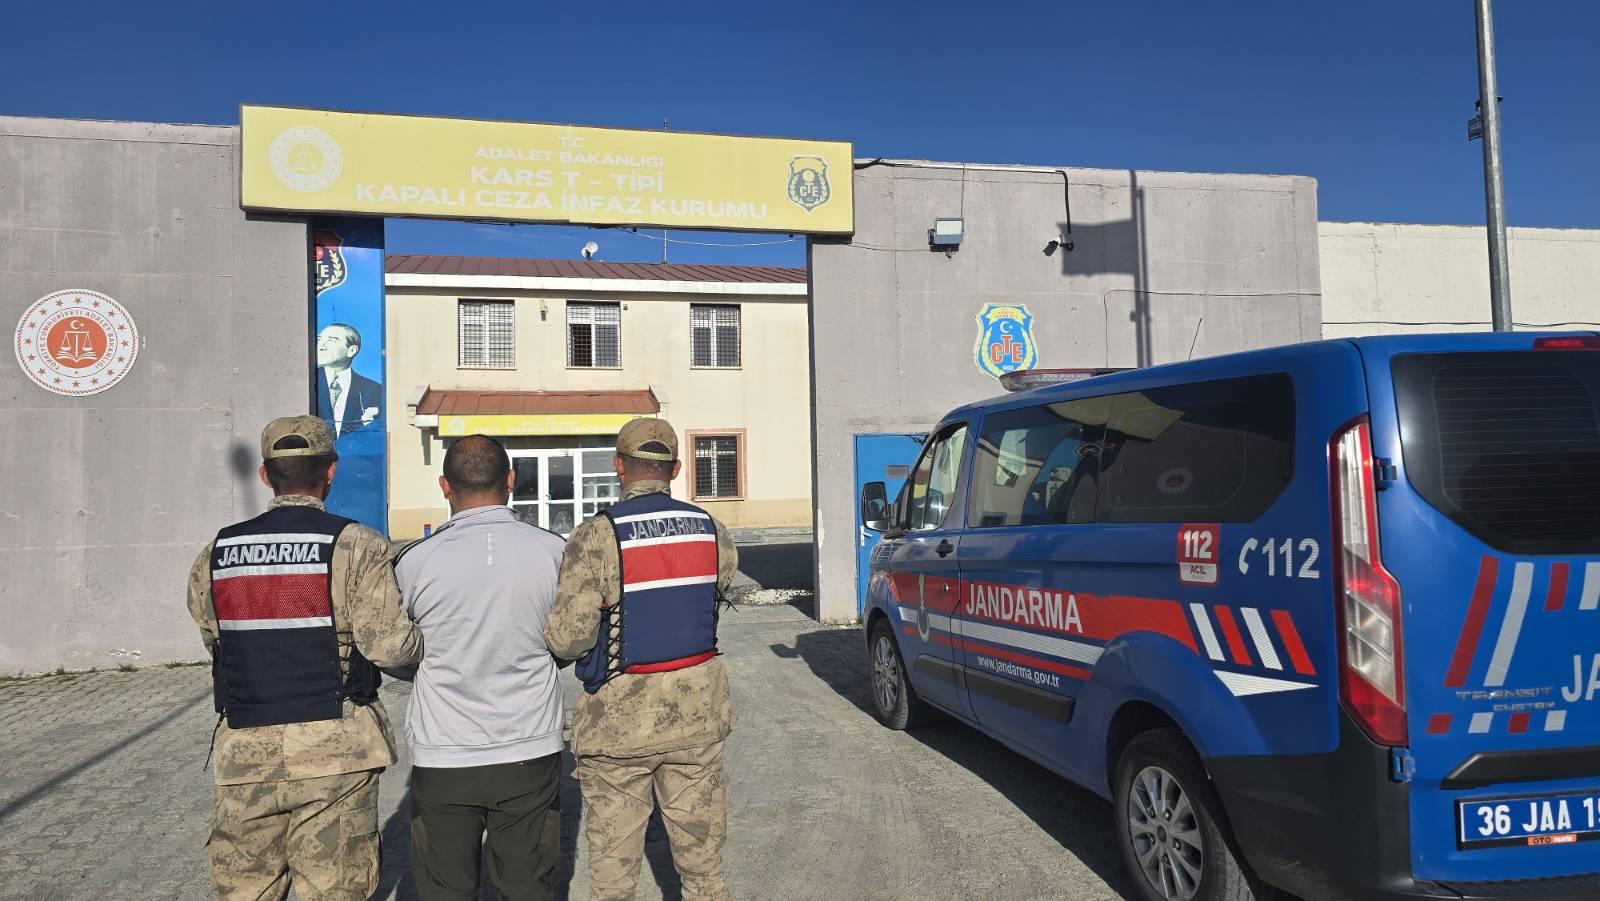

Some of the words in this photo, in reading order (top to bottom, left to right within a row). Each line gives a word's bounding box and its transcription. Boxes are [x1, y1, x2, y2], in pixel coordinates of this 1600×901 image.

[475, 146, 554, 162] ADALET
[560, 151, 664, 168] BAKANLIĞI
[471, 165, 553, 187] KARS
[562, 171, 580, 188] T
[610, 171, 664, 193] TİPİ
[800, 182, 819, 197] CTE
[356, 183, 465, 206] KAPALI
[475, 189, 553, 209] CEZA
[561, 190, 643, 214] İNFAZ
[651, 199, 767, 220] KURUMU
[991, 335, 1023, 363] CTE
[629, 517, 706, 540] JANDARMA
[218, 543, 320, 566] JANDARMA
[1184, 530, 1212, 558] 112
[1262, 538, 1320, 579] 112
[966, 584, 1083, 633] JANDARMA
[977, 656, 1060, 688] www.jandarma.gov.tr
[1477, 804, 1511, 836] 36
[1522, 800, 1571, 832] JAA
[1583, 797, 1600, 829] 1
